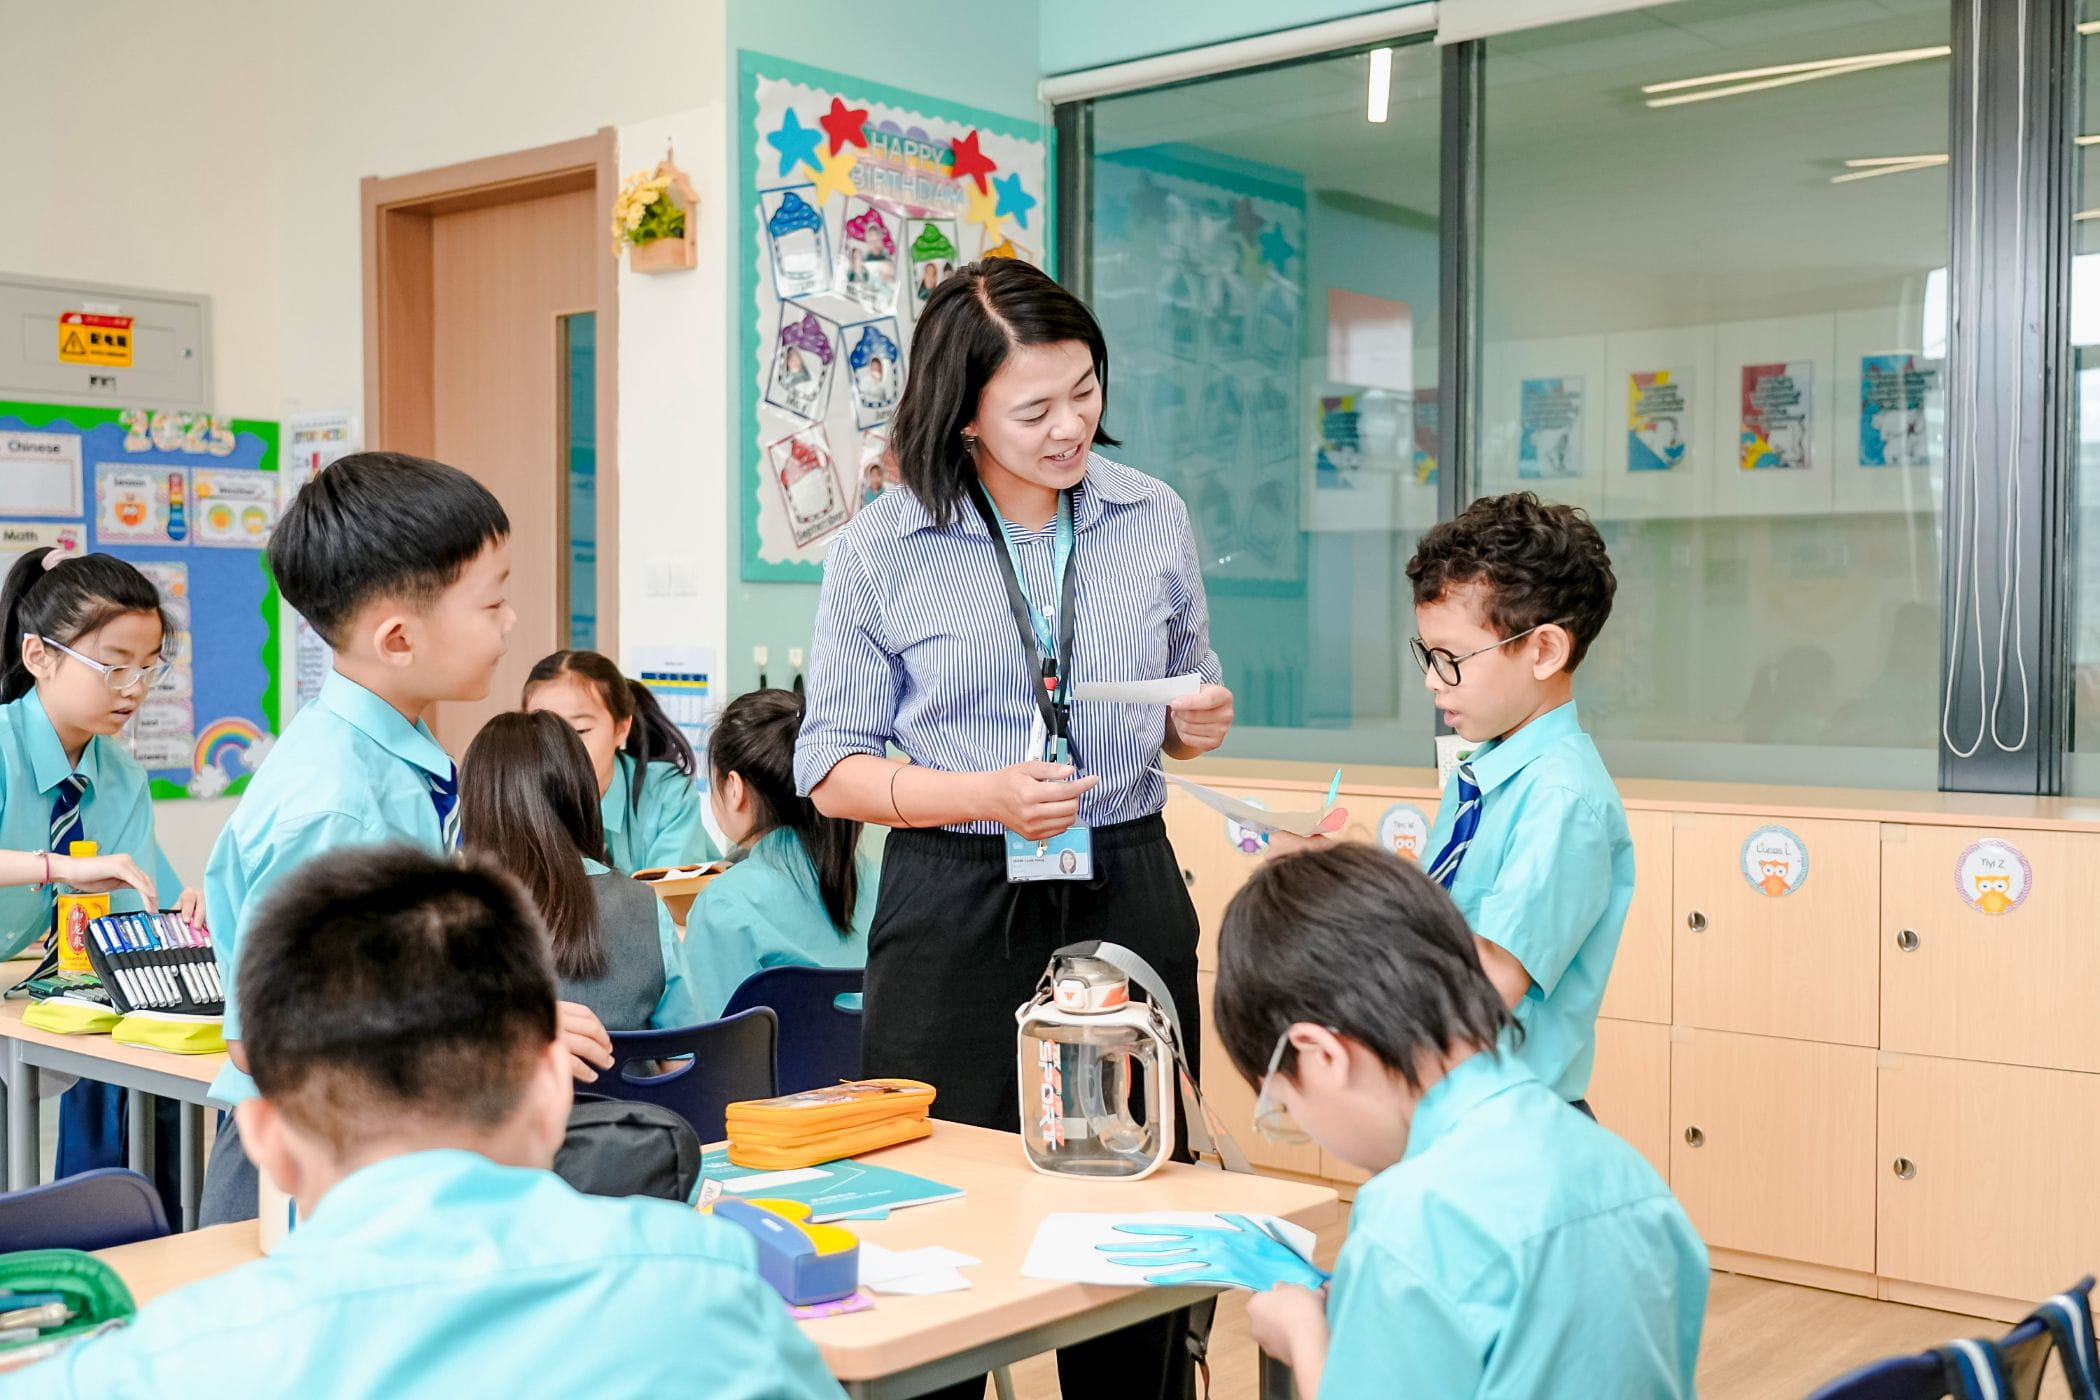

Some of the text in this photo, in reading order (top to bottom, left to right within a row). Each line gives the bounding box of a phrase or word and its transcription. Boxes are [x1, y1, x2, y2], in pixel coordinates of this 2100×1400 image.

[870, 131, 946, 163] HAPPY
[850, 163, 965, 204] BIRTHDAY
[8, 440, 61, 453] Chinese
[118, 408, 236, 458] 2025
[3, 530, 38, 542] Math
[797, 510, 844, 541] September
[1756, 844, 1783, 855] Lucas
[1998, 859, 2006, 869] Z
[1038, 1040, 1057, 1150] SPORT
